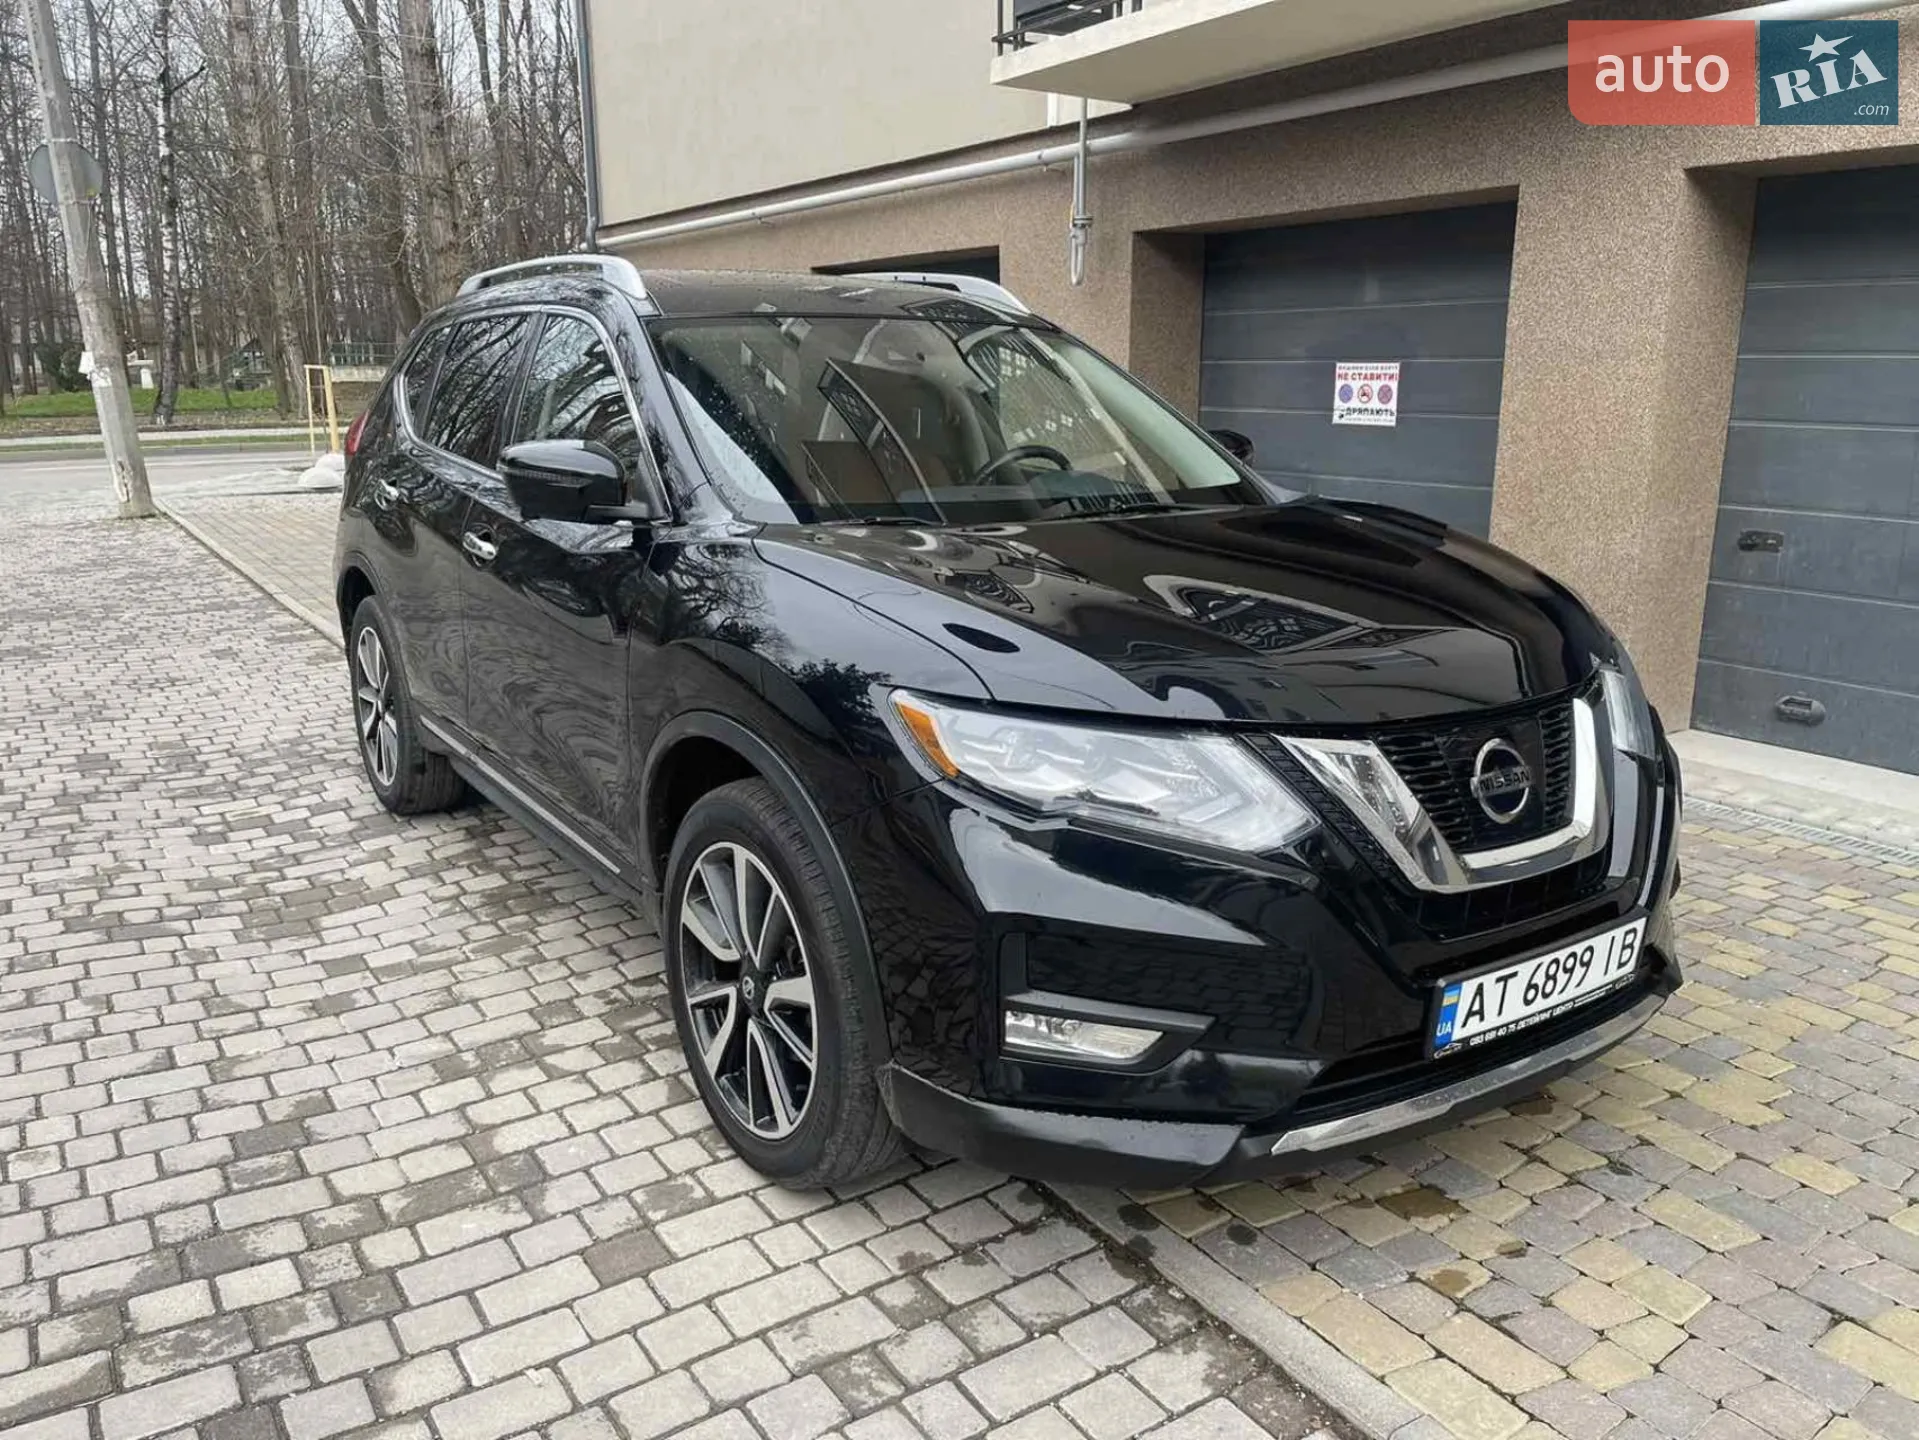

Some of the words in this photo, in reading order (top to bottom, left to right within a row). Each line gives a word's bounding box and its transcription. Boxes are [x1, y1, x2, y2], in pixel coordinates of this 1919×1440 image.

[1337, 372, 1349, 380] НЕ
[1480, 771, 1529, 789] NISSAN
[1460, 970, 1519, 1029] AT
[1523, 945, 1595, 1007] 6899
[1603, 927, 1638, 976] IB
[1436, 1022, 1453, 1037] UA
